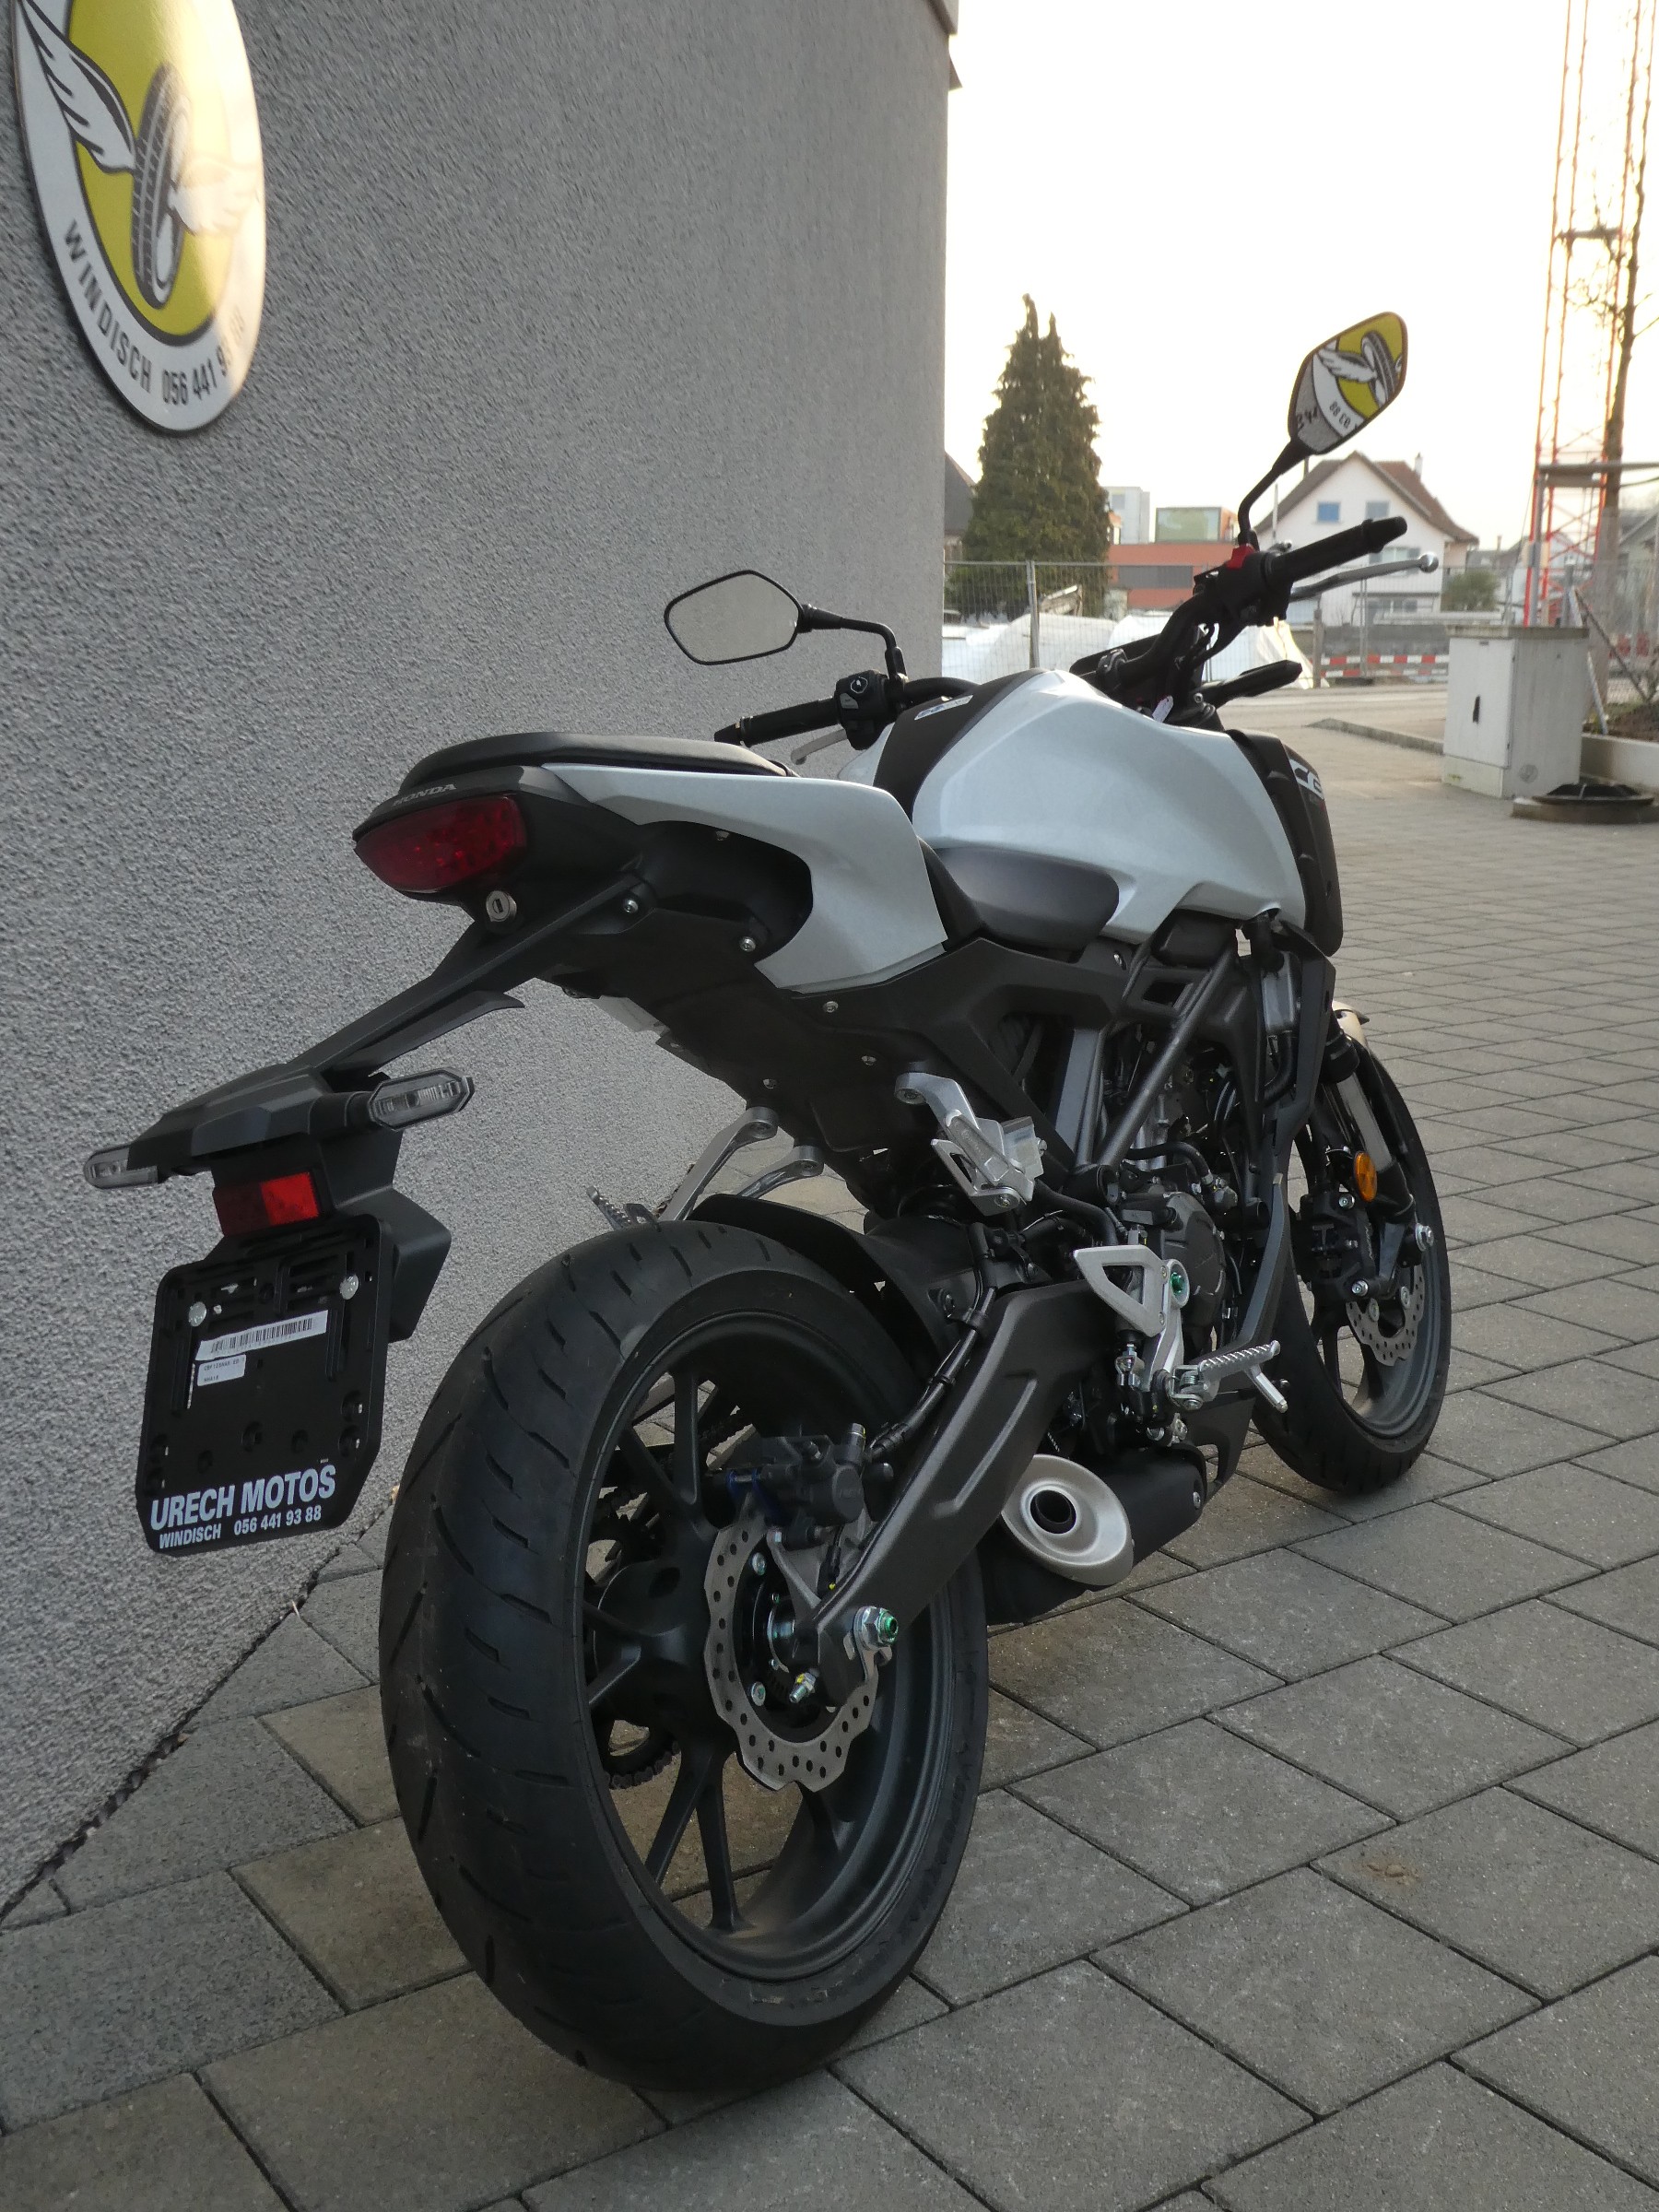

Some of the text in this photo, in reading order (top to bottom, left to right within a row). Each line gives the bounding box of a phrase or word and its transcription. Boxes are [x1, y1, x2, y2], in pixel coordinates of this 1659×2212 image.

[65, 218, 152, 394] WINDISCH
[162, 369, 189, 406] 056
[192, 358, 218, 401] 441
[393, 783, 457, 807] HONDA
[150, 1465, 336, 1530] URECH MOTOS
[159, 1504, 323, 1549] WINDISCH 056 441 93 88
